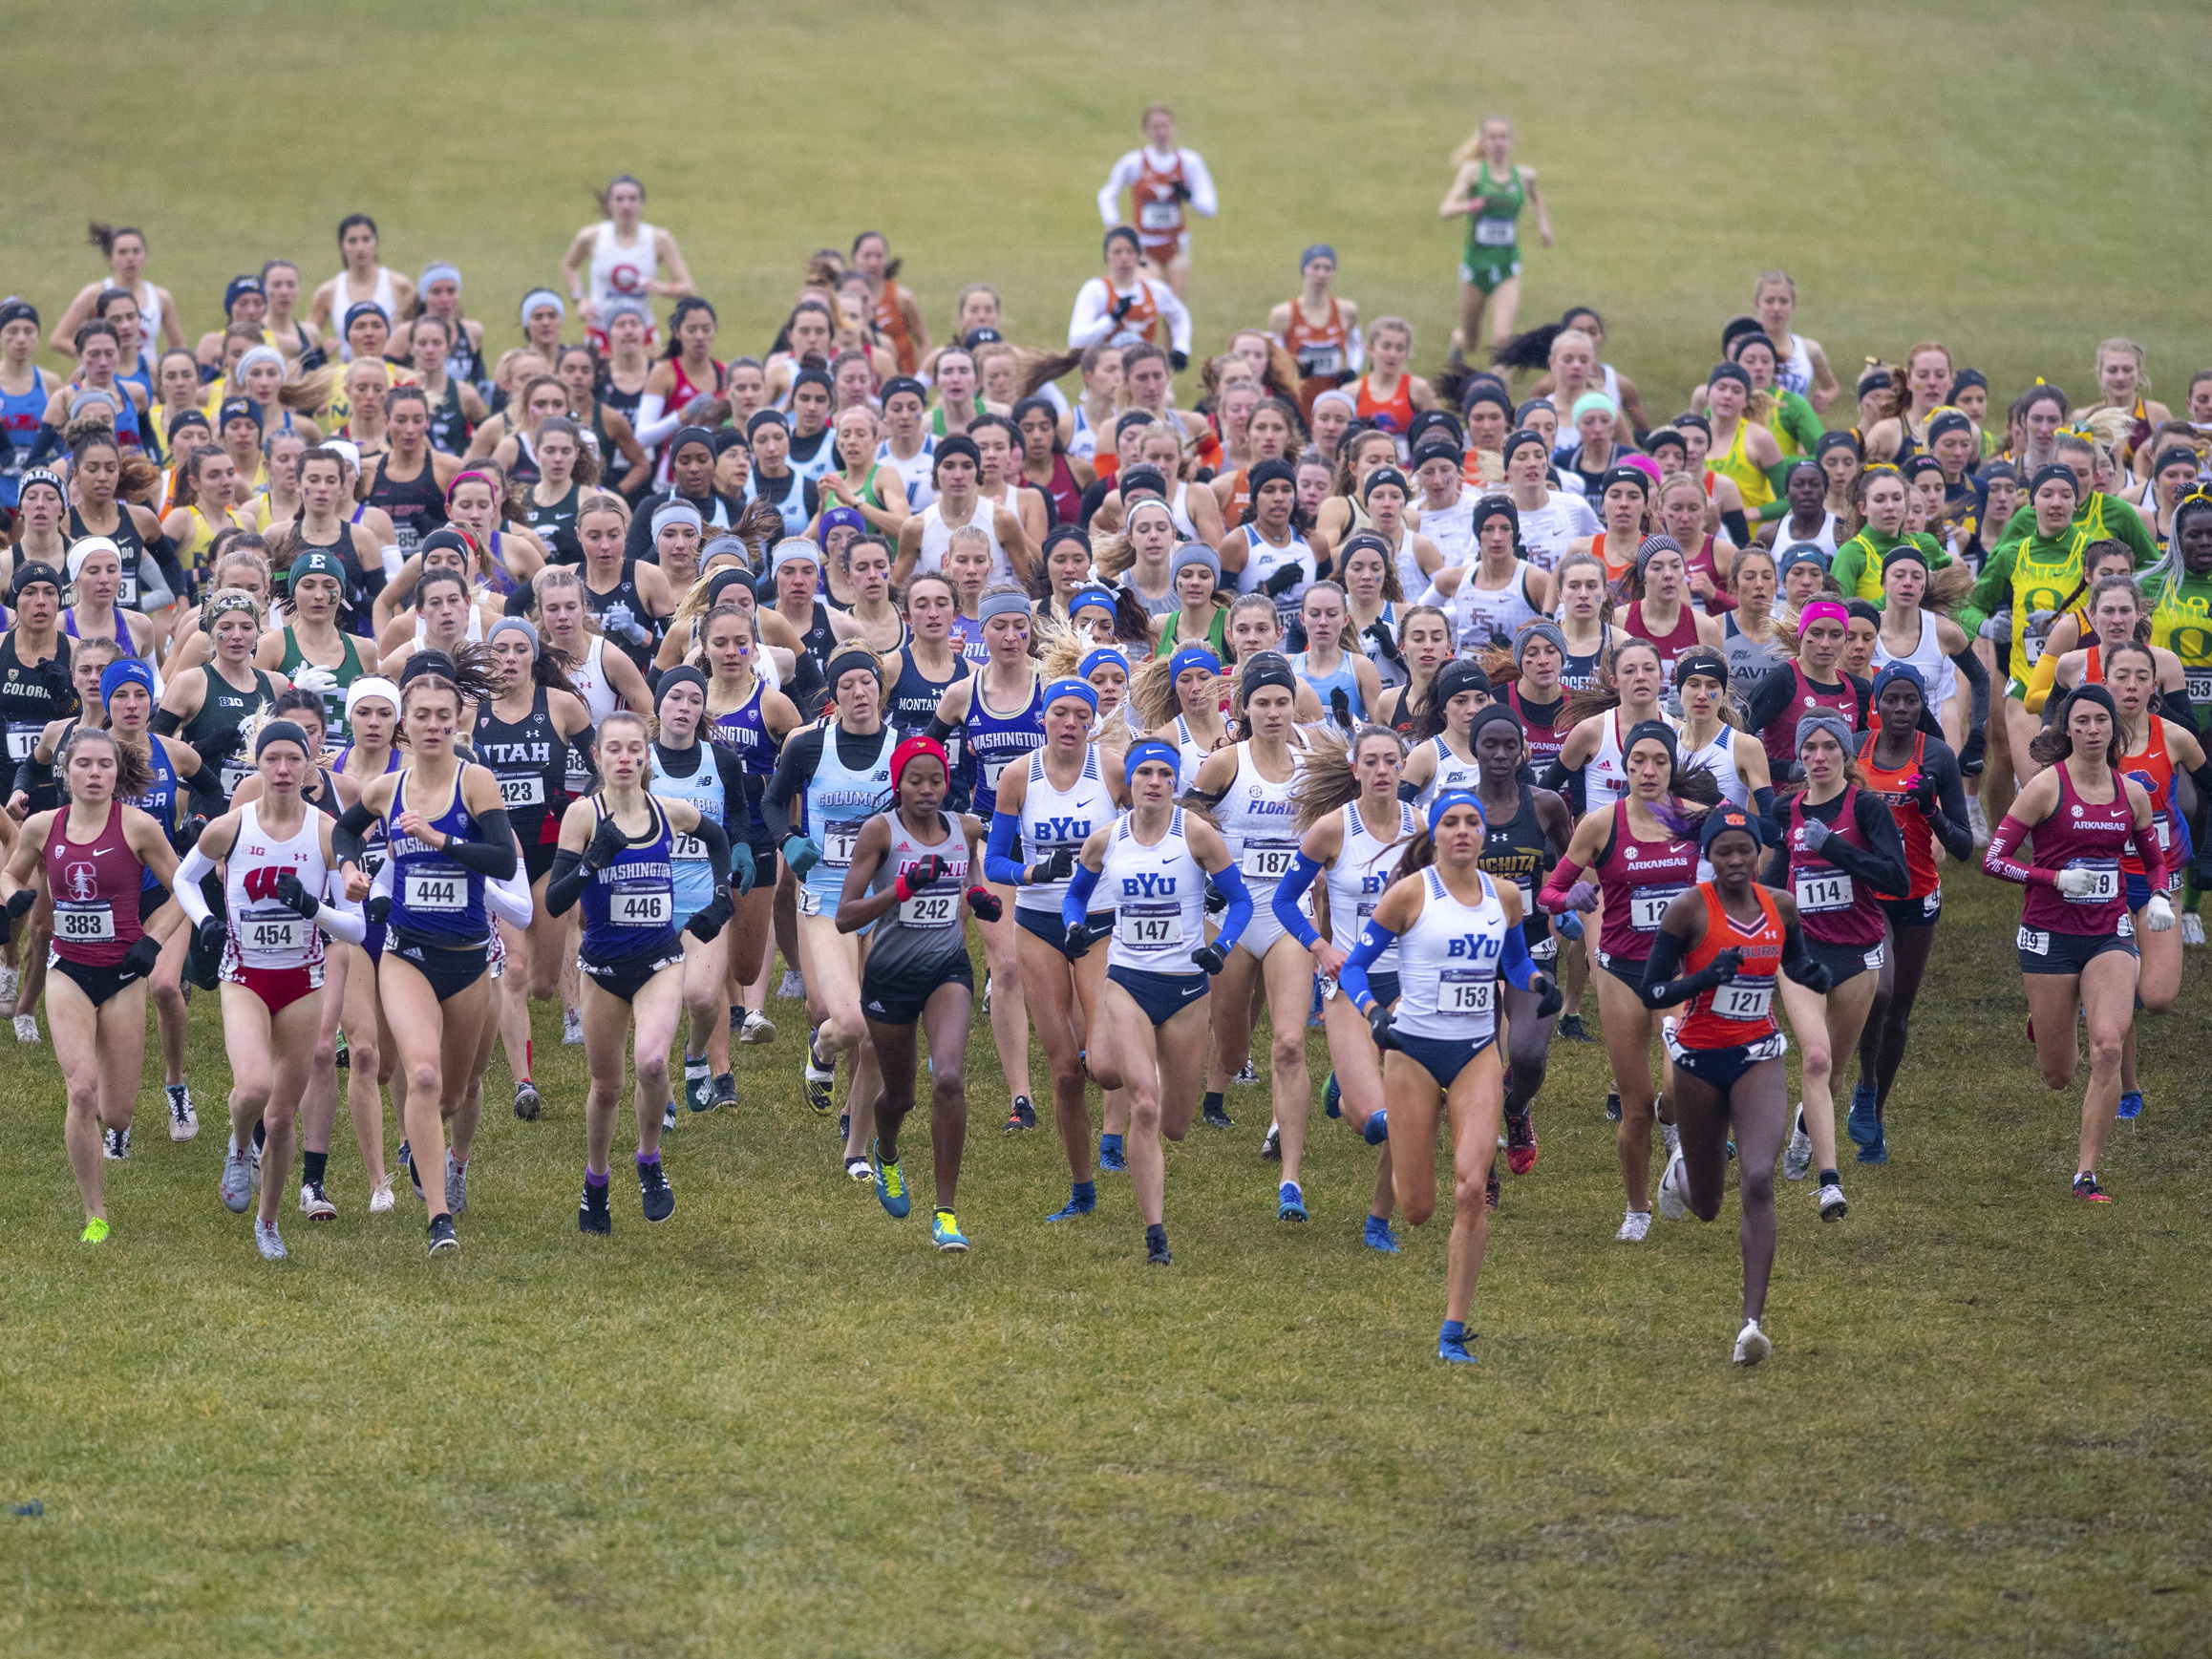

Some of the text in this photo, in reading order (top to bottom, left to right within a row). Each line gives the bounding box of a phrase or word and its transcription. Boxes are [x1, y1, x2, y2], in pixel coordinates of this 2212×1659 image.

[611, 264, 639, 293] C
[309, 554, 327, 568] E
[327, 590, 338, 605] E
[1397, 722, 1414, 731] ACC
[971, 732, 1047, 751] WASHINGTON
[500, 781, 532, 802] 423
[1034, 817, 1091, 841] BYU
[2073, 820, 2126, 832] ARKANSAS
[1256, 853, 1291, 873] 187
[1627, 857, 1688, 871] ARKANSAS
[1987, 859, 2005, 873] PIG
[2001, 863, 2030, 883] SOOIE
[417, 882, 455, 903] 444
[1122, 873, 1177, 898] BYU
[1805, 880, 1840, 904] 114
[624, 897, 662, 918] 446
[913, 900, 949, 920] 242
[65, 914, 102, 934] 383
[1134, 920, 1170, 941] 147
[253, 925, 292, 946] 454
[1447, 933, 1500, 960] BYU
[1719, 944, 1780, 959] ABURN
[1454, 987, 1488, 1008] 153
[1730, 991, 1762, 1012] 121
